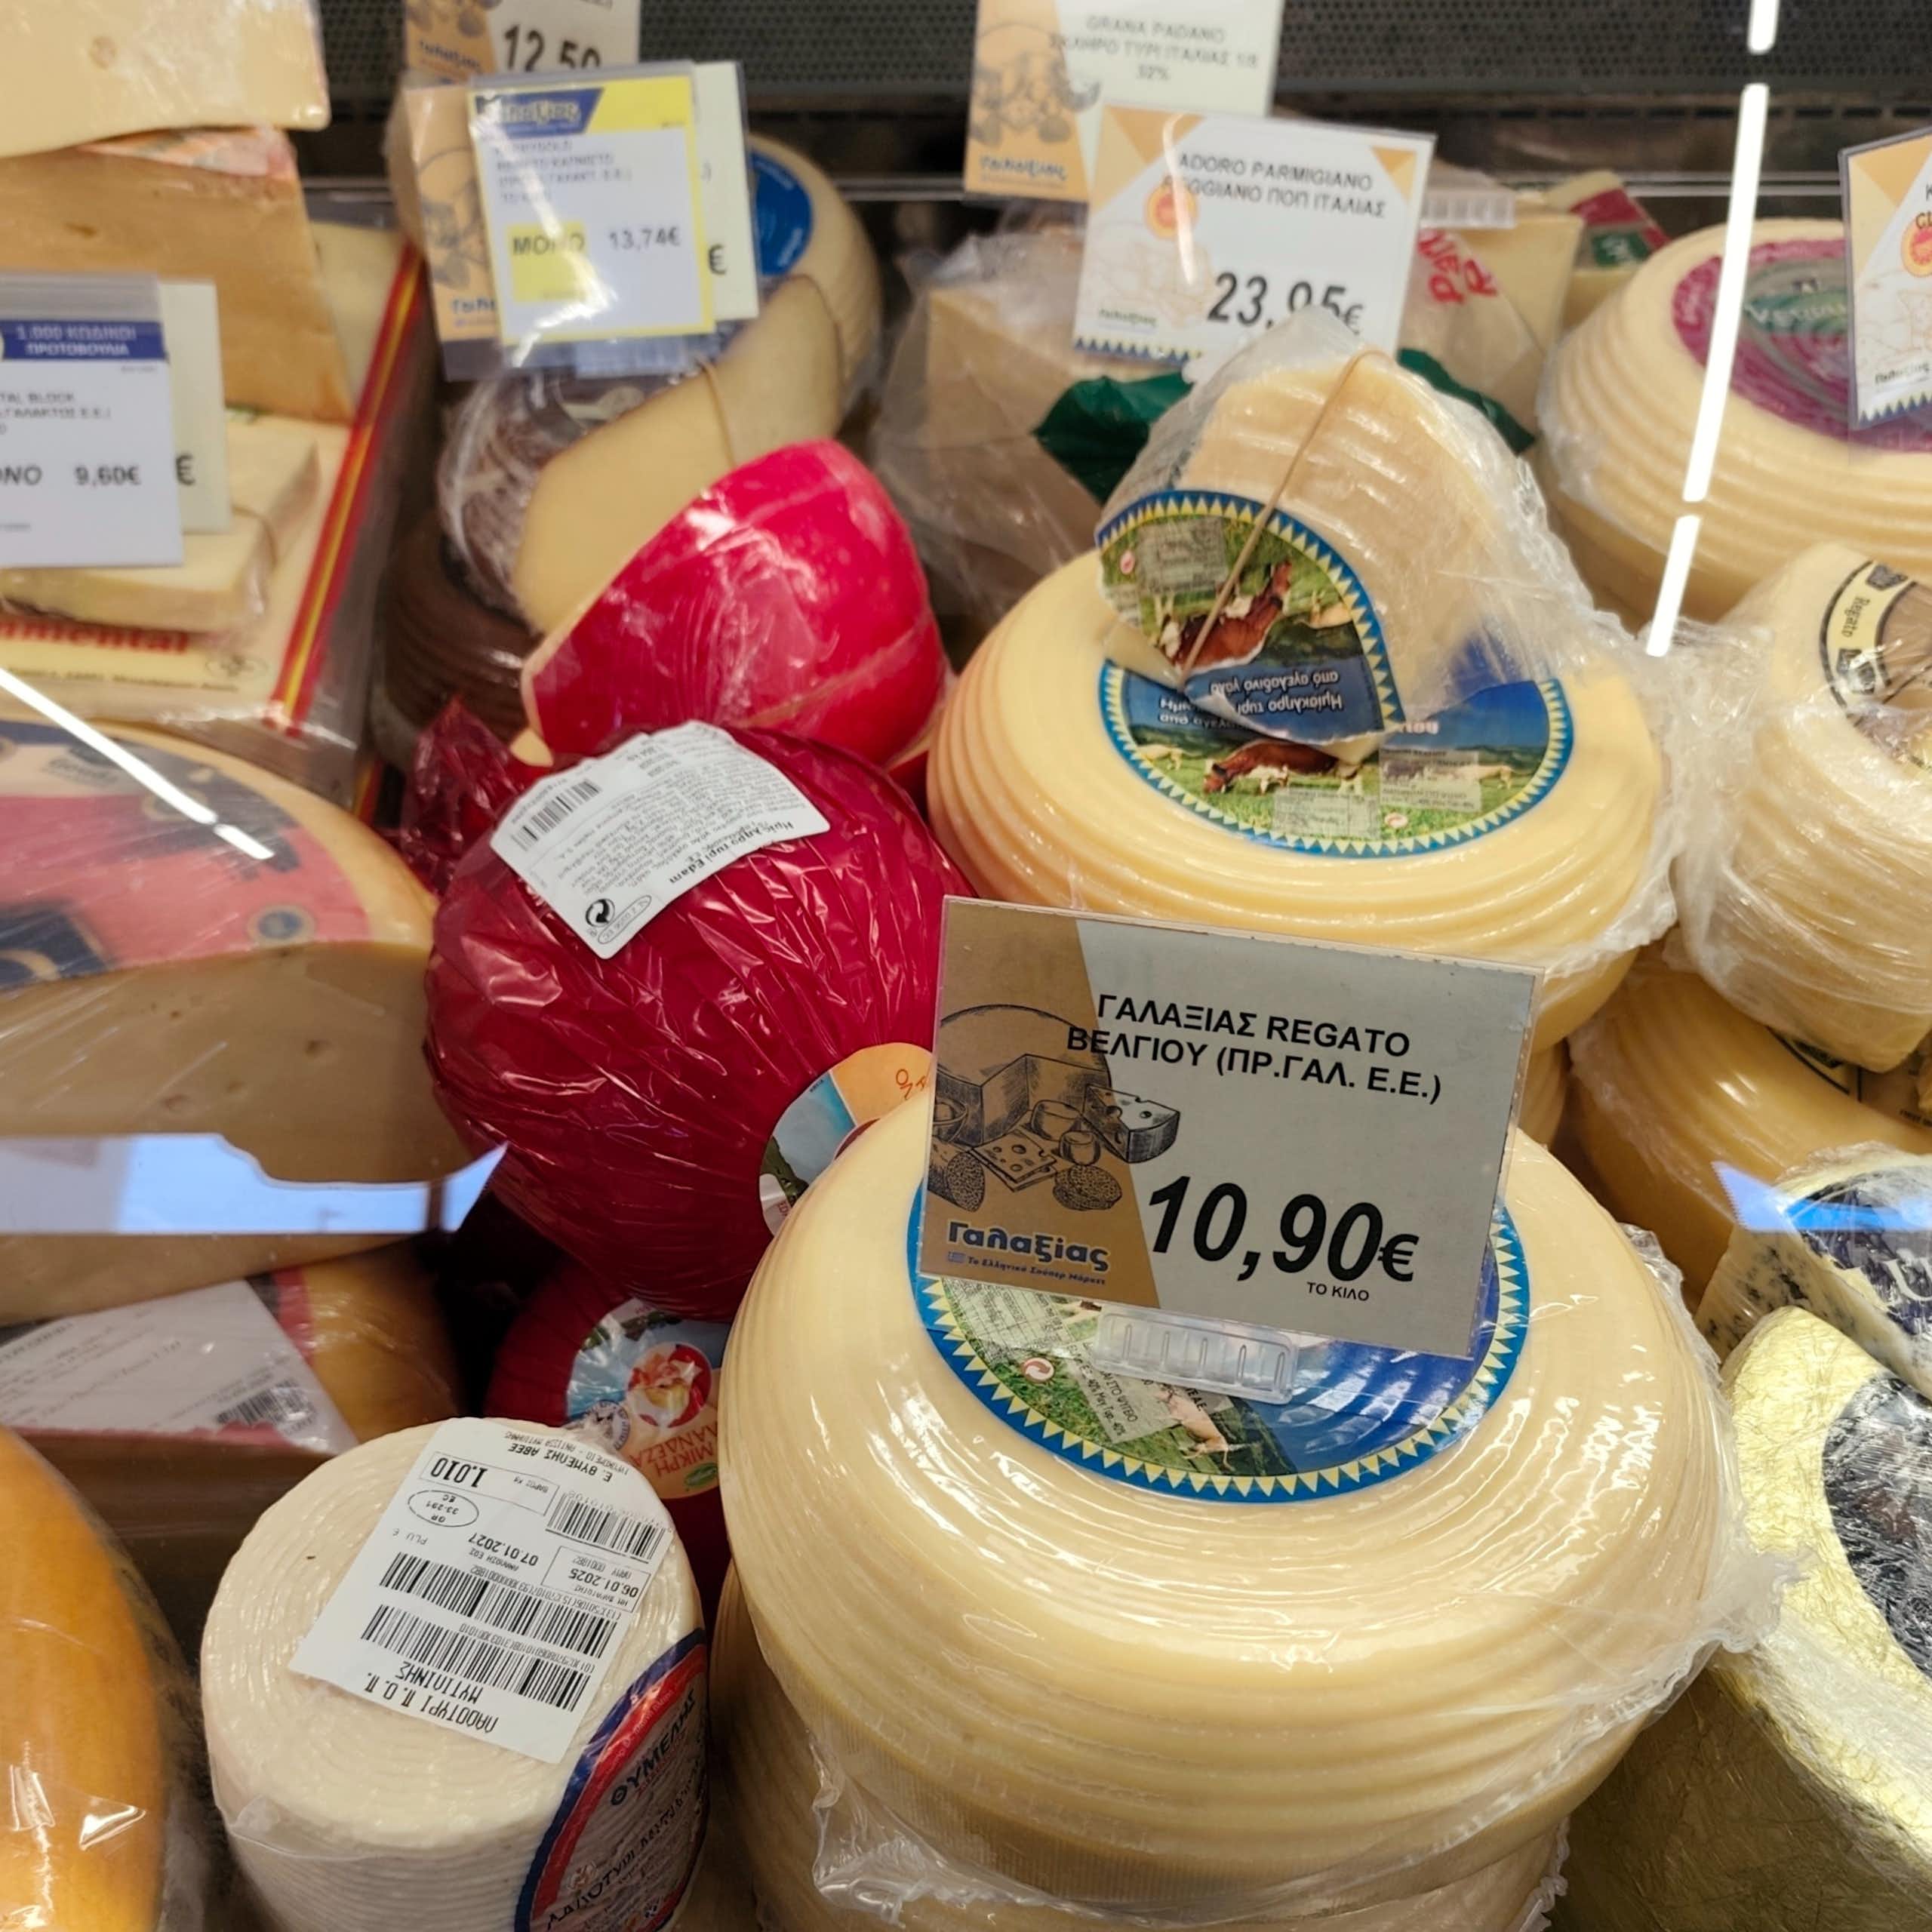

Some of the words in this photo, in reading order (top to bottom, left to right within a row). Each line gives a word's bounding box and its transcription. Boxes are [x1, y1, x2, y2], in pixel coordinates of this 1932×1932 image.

[1250, 160, 1374, 192] PARMIGIANO
[513, 231, 586, 255] ΜΟΟ
[707, 243, 728, 275] €
[75, 465, 142, 487] 9,60€
[174, 453, 195, 487] €
[1243, 674, 1311, 694] αγελαδινό
[1268, 693, 1343, 716] Ημίσκληρο
[669, 857, 705, 884] Edam
[1097, 994, 1258, 1037] ΓΑΛΑΞΙΑΣ
[1266, 1017, 1411, 1057] REGATO
[1066, 1027, 1208, 1069] ΒΕΛΓΙΟΥ
[1216, 1044, 1355, 1088] (ΠΡ.ΓΑΛ.
[1367, 1067, 1442, 1105] Ε.Ε.)
[1147, 1175, 1420, 1284] 10,90€
[1306, 1281, 1327, 1297] ΤΟ
[1331, 1284, 1371, 1303] ΚΙΛΟ
[508, 1442, 541, 1457] ΑΒΕΕ
[543, 1450, 598, 1477] ΘΥΜΕΛΗΣ
[655, 1442, 714, 1478] ΜΙΚΡΗ
[429, 1457, 488, 1488] 1.010
[468, 1532, 540, 1567] 07.01.2027
[568, 1567, 639, 1598] 06.01.2025
[420, 1694, 500, 1734] ΛΑΔΟΤΥΡΙ
[610, 1687, 697, 1807] ΘΥΜΕΛΗΣ
